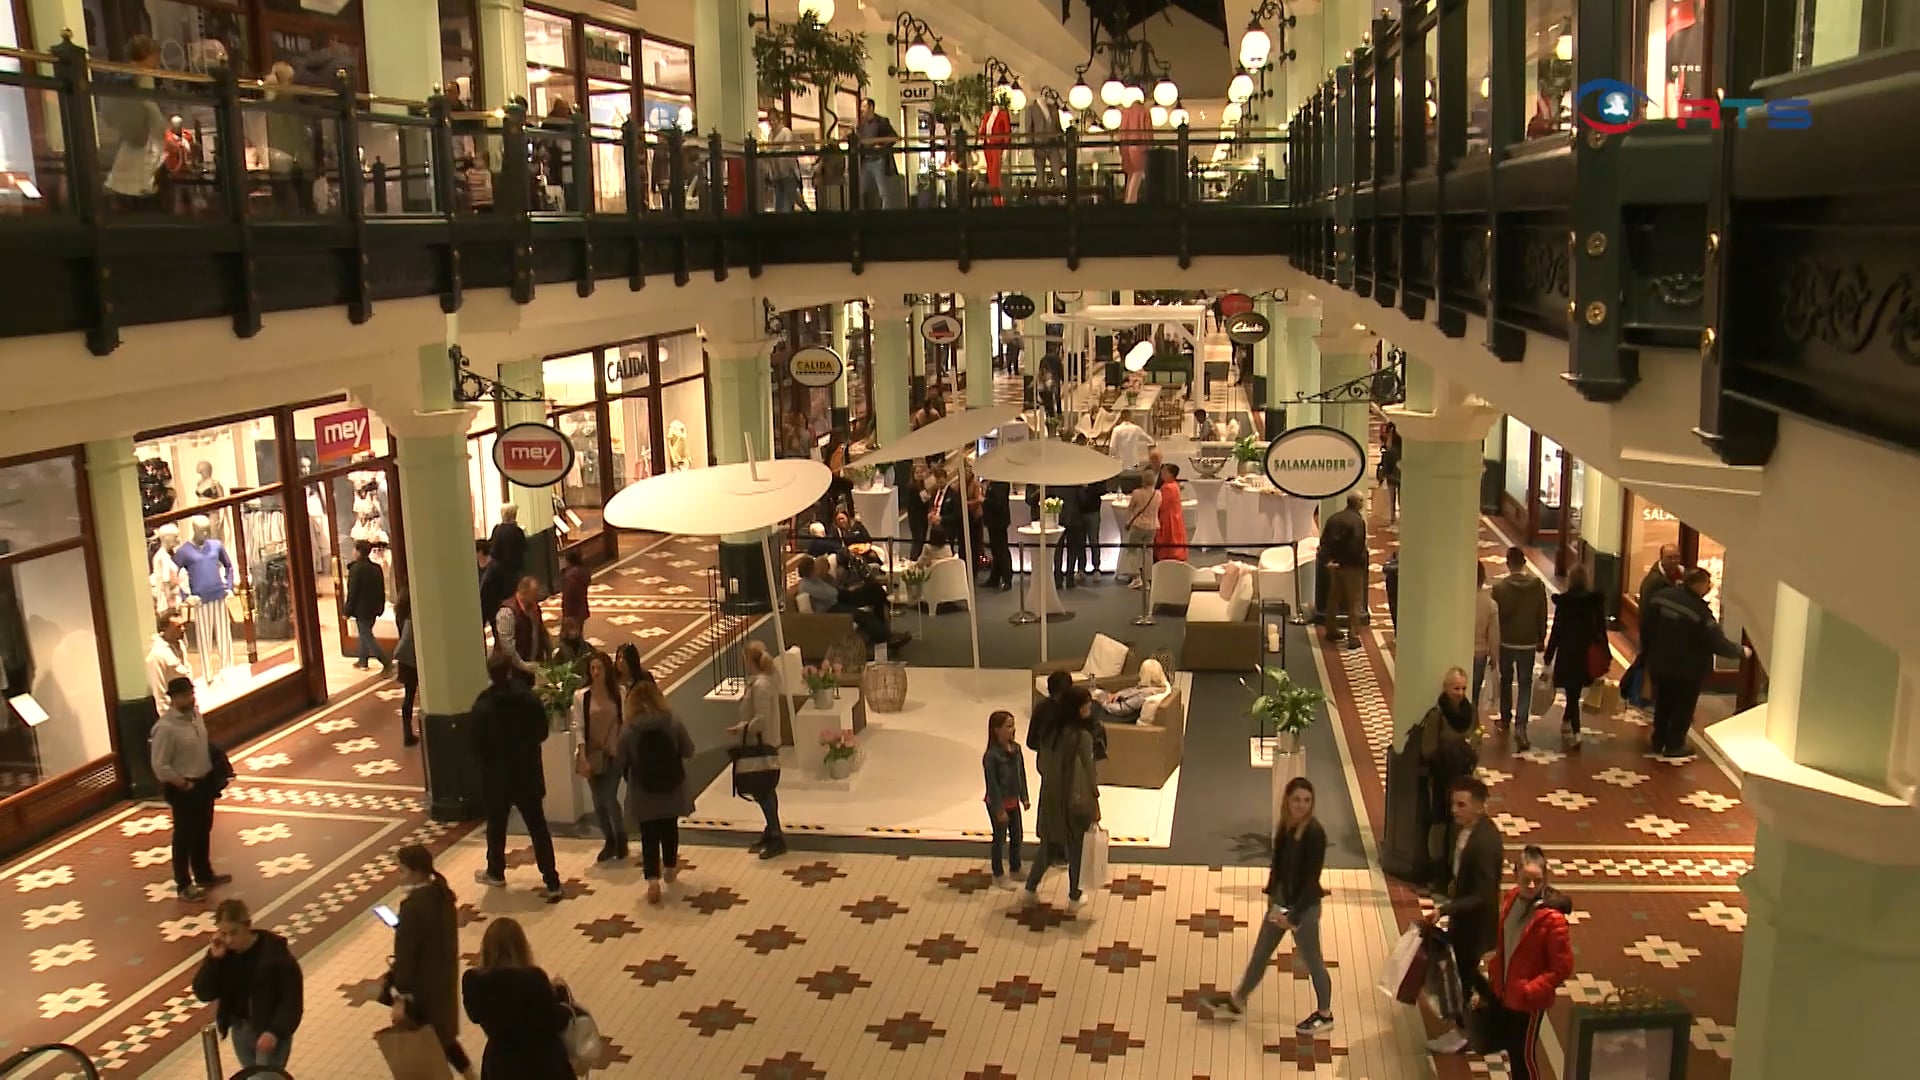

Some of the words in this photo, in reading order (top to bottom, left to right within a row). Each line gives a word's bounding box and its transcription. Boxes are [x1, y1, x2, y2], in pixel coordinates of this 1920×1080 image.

[607, 355, 649, 383] CALIDA
[796, 360, 833, 370] CALIDA
[324, 417, 367, 449] mey
[511, 447, 556, 466] mey
[1274, 459, 1346, 471] SALAMANDER
